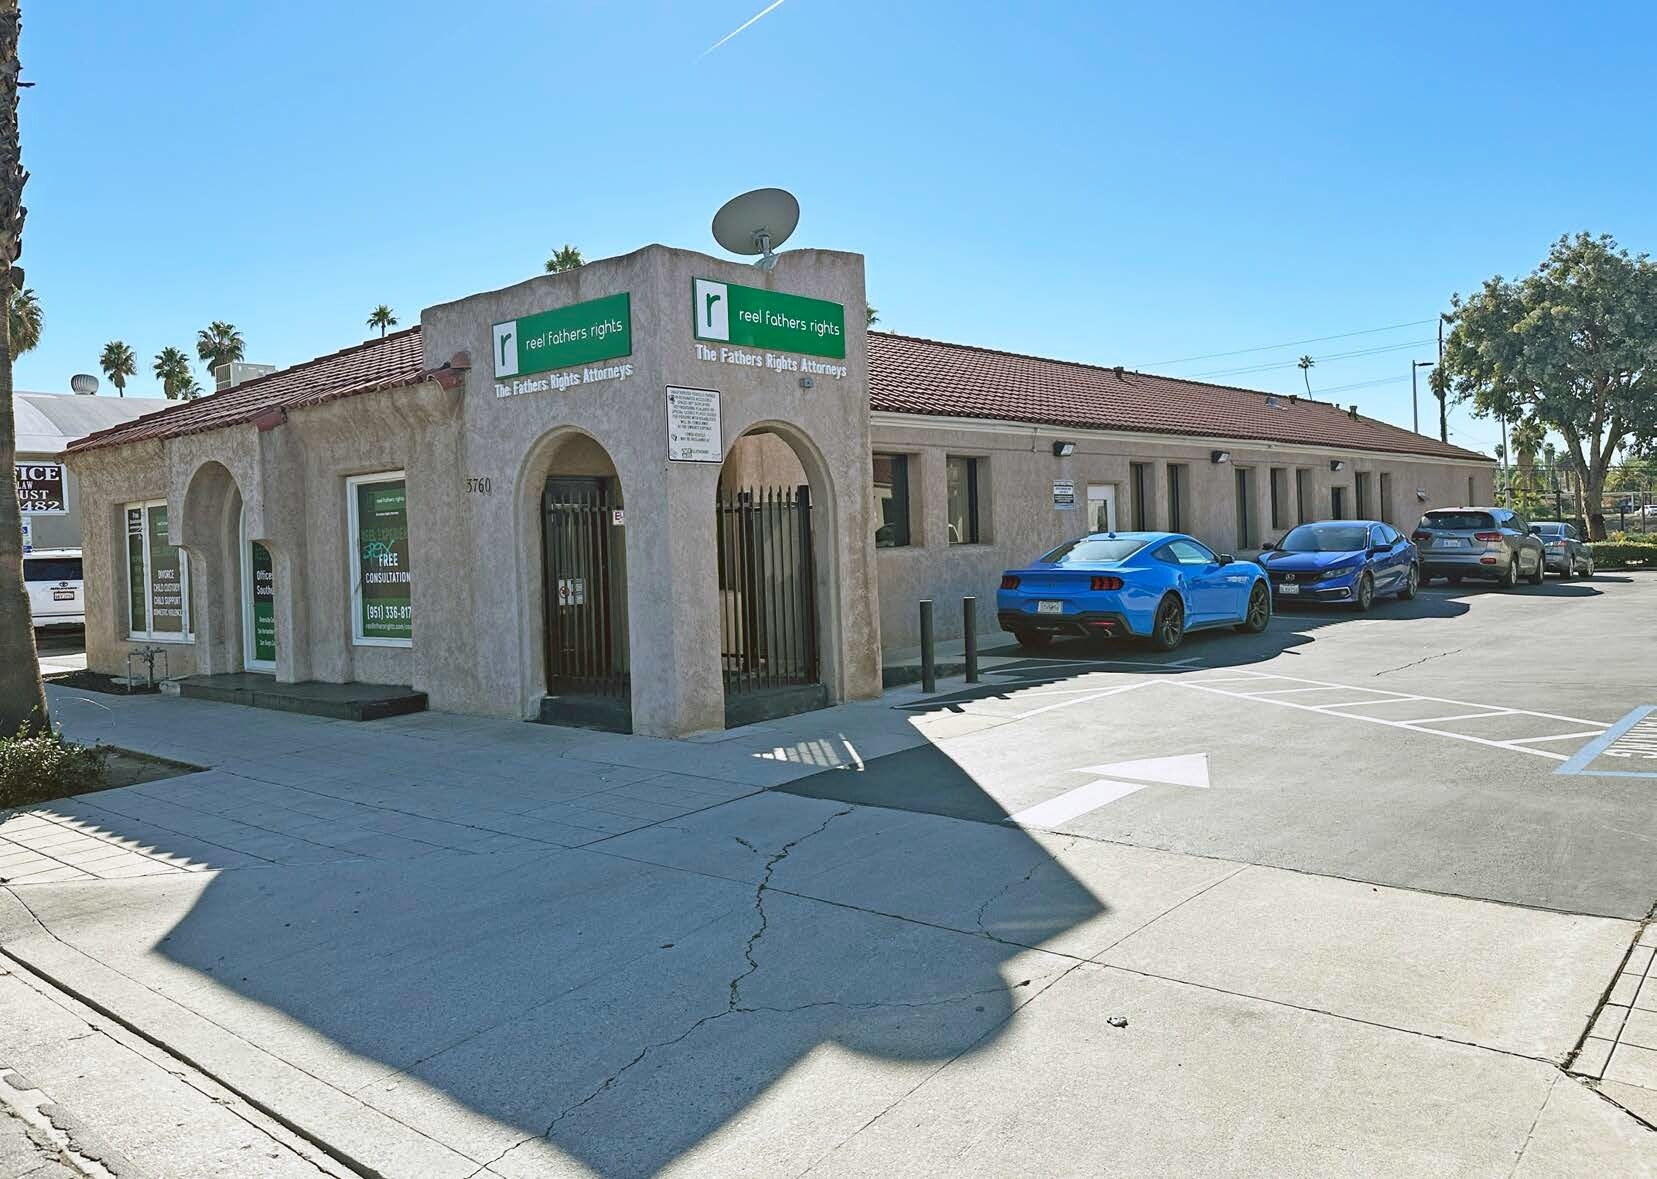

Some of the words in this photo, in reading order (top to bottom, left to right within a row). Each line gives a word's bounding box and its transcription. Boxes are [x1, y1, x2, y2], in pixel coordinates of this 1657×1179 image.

[739, 309, 762, 323] reel
[765, 310, 807, 331] fathers
[810, 319, 840, 337] rights
[526, 333, 546, 350] reel
[548, 327, 587, 346] fathers
[590, 318, 623, 340] rights
[694, 344, 717, 361] The
[719, 348, 763, 367] Fathers
[765, 353, 798, 372] Rights
[800, 358, 847, 379] Attorneys
[494, 384, 512, 398] The
[512, 378, 548, 395] Fathers
[550, 371, 580, 391] Rights
[582, 364, 633, 383] Attorneys
[465, 478, 491, 493] 3760
[379, 553, 398, 567] FREE
[365, 571, 411, 584] CONSULTATION
[164, 596, 181, 605] SUPPORT
[367, 604, 384, 620] (951)
